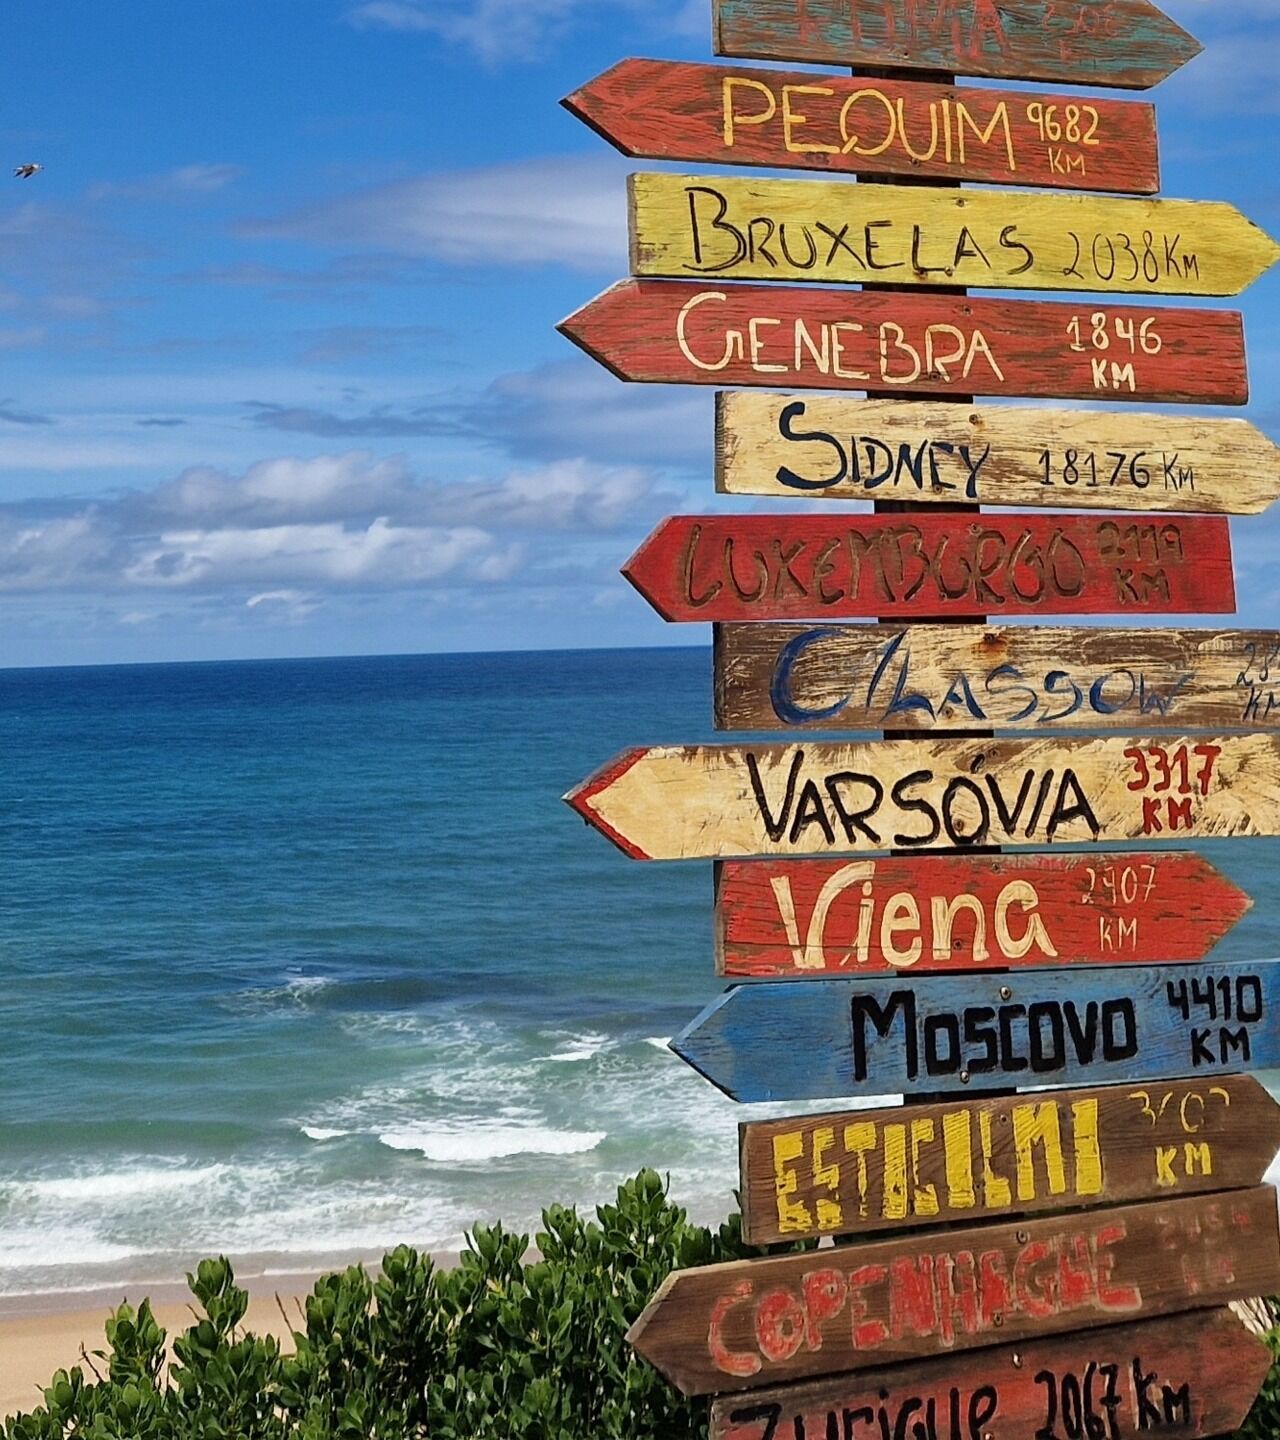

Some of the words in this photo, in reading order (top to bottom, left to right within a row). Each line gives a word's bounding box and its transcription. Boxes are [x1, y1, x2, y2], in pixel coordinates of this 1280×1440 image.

[722, 76, 1016, 171] PEQUIM
[1027, 102, 1101, 146] 9682
[1048, 147, 1087, 177] KM
[682, 186, 1034, 276] BRUXELAS
[676, 291, 1006, 385] GENEBRA
[1066, 312, 1162, 355] 1846
[1091, 357, 1137, 393] KM
[775, 401, 990, 499] SIDNEY
[1037, 448, 1151, 489] 18176
[682, 523, 1087, 607] LUXEMBURGO
[1116, 567, 1171, 605] KM
[1123, 745, 1222, 796] 3317
[746, 750, 1101, 846] VARSÓVIA
[1142, 796, 1194, 835] KM
[770, 861, 1059, 969] Viena
[1099, 916, 1138, 953] KM
[1166, 975, 1263, 1023] 4410
[1190, 1026, 1252, 1068] KM
[1155, 1142, 1212, 1187] KM
[1034, 1361, 1122, 1440] 2067
